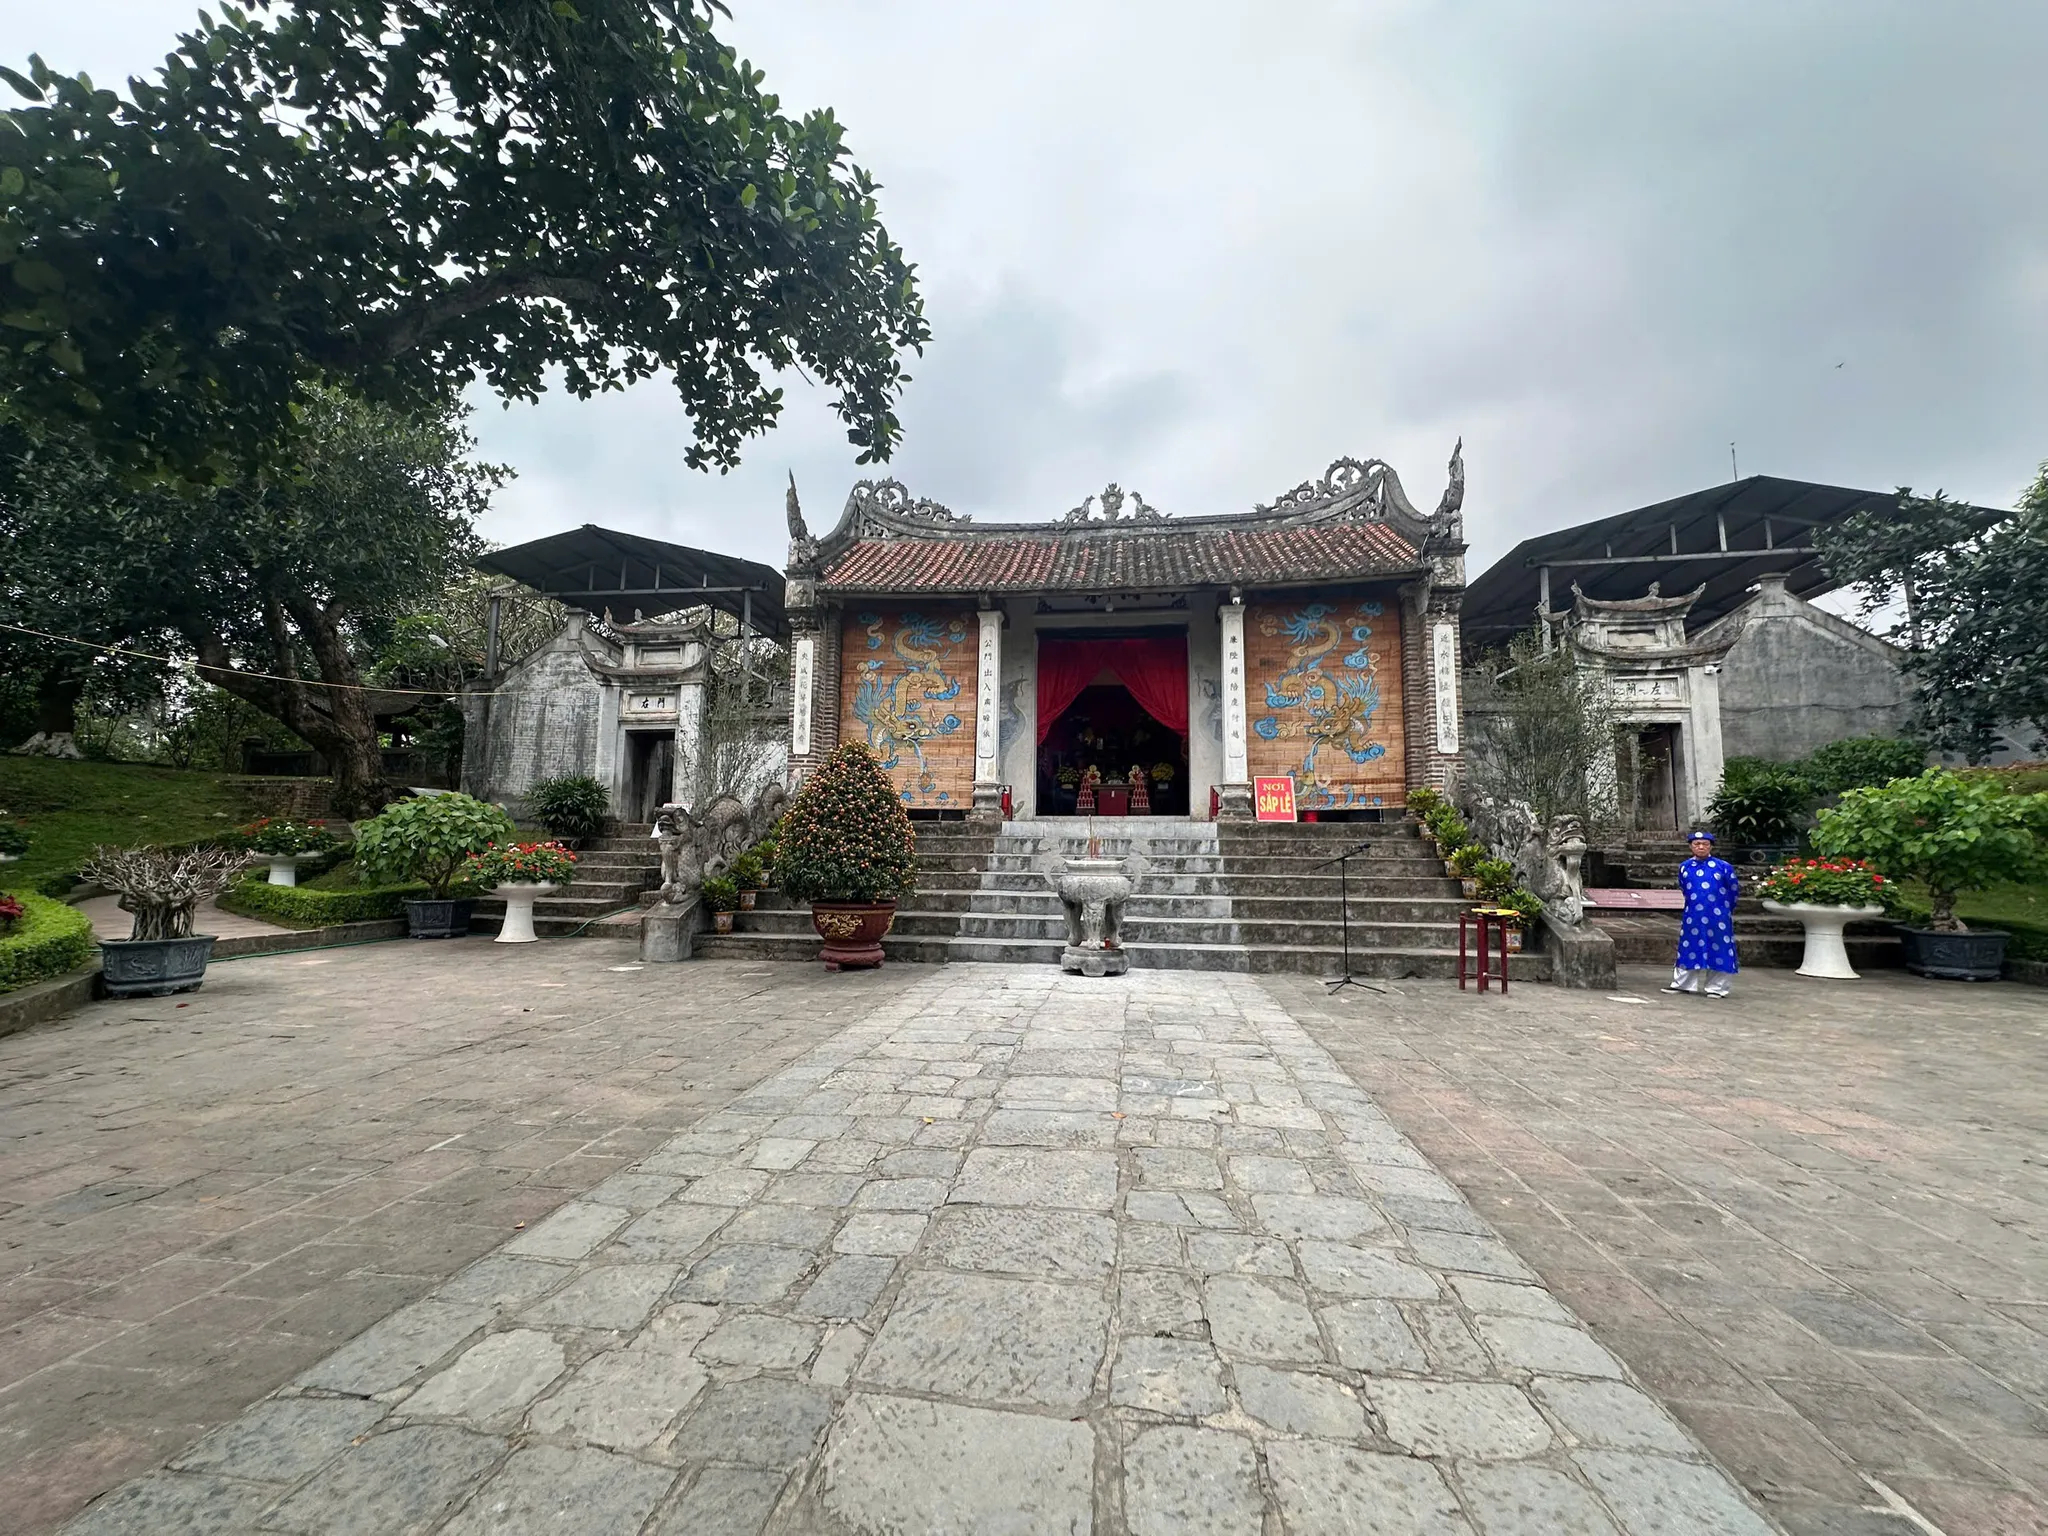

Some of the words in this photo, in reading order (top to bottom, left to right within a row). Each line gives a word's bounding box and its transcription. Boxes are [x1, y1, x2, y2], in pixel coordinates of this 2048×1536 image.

[1262, 783, 1285, 791] NƠI
[1260, 791, 1279, 812] SẮP
[1280, 792, 1292, 813] LỄ
